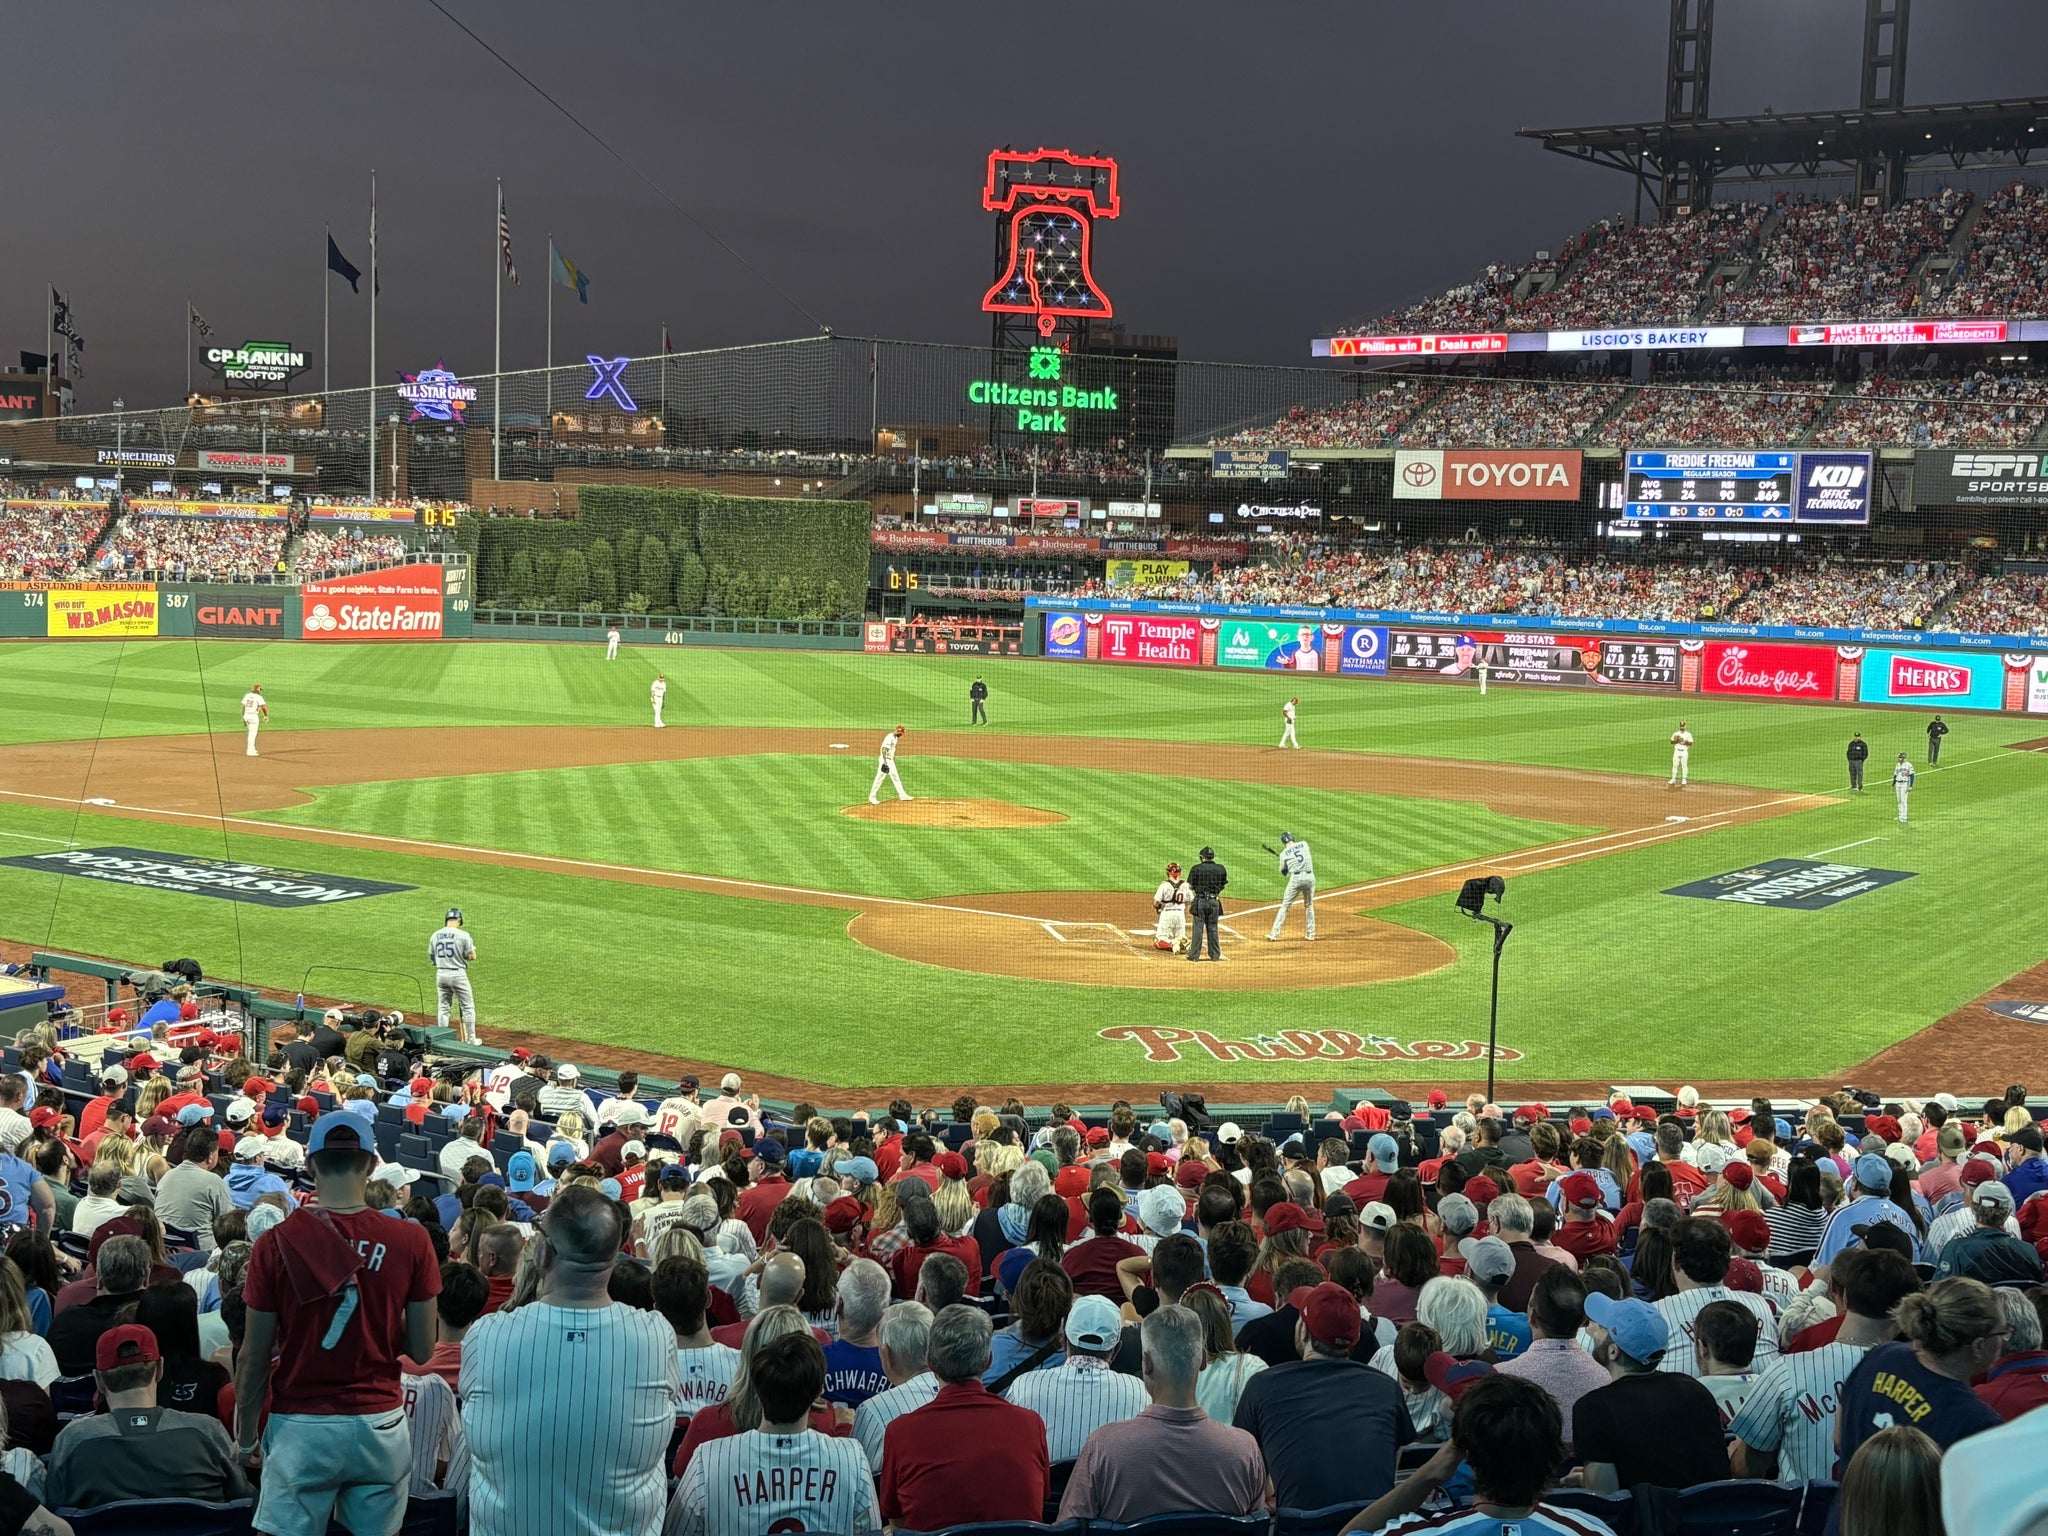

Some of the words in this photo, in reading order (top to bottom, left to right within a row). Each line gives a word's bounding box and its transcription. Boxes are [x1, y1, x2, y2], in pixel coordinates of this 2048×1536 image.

[1582, 334, 1642, 346] LISCIO'S
[1649, 333, 1708, 344] BAKERY
[1830, 334, 1877, 343] FAVORITE
[1881, 334, 1926, 342] PROTEIN
[1938, 330, 1996, 338] INGREDIENTS
[1360, 342, 1396, 352] Phillies
[1399, 342, 1417, 351] win
[1440, 340, 1468, 350] Deals
[1471, 340, 1489, 349] roll
[1491, 339, 1501, 348] in
[226, 370, 286, 380] ROOFTOP
[398, 385, 420, 397] ALL
[420, 385, 447, 399] STAR
[448, 386, 477, 400] GAME
[969, 382, 1057, 406] Citizens
[1062, 386, 1118, 409] Bank
[1018, 409, 1067, 432] Park
[1637, 456, 1643, 466] 5
[1666, 455, 1707, 468] FREDDIE
[1708, 455, 1756, 468] FREEMAN
[1951, 455, 2039, 477] ESPN
[1451, 464, 1569, 486] TOYOTA
[1809, 465, 1866, 488] KDI
[1641, 480, 1660, 488] AVG
[1758, 481, 1778, 489] OPS
[1680, 489, 1697, 500] 24
[1719, 490, 1736, 500] 90
[1820, 489, 1851, 500] OFFICE
[1988, 496, 2019, 504] problem?
[2020, 496, 2034, 504] Call
[1806, 498, 1864, 511] TECHNOLOGY
[216, 505, 257, 517] Surfside
[333, 508, 372, 520] Surfside
[889, 533, 935, 545] Budweiser
[957, 535, 1007, 547] #HITTHEBUDS
[1042, 538, 1088, 550] Budweiser
[1142, 564, 1170, 575] PLAY
[27, 582, 82, 590] ASPLUNDH
[95, 583, 149, 591] ASPLUNDH
[307, 585, 323, 593] Like
[329, 586, 346, 595] good
[378, 586, 395, 594] State
[397, 586, 412, 594] Farm
[414, 586, 420, 594] is
[421, 586, 440, 595] there.
[24, 593, 44, 607] 374
[54, 602, 70, 610] WHO
[72, 601, 85, 609] BUT
[166, 595, 189, 608] 387
[453, 600, 469, 612] 409
[197, 606, 283, 626] GIANT
[1410, 614, 1452, 623] Independence
[1551, 619, 1596, 629] Independence
[1638, 623, 1666, 632] ibx.com
[1701, 625, 1749, 635] Independence
[664, 632, 684, 644] 401
[1138, 621, 1196, 643] Temple
[1795, 630, 1824, 638] ibx.com
[1861, 632, 1912, 642] Independence
[1360, 638, 1371, 649] R
[1504, 634, 1527, 643] 2025
[1527, 635, 1556, 645] STATS
[1960, 636, 1992, 645] ibx.com
[1138, 641, 1191, 660] Health
[1509, 647, 1549, 658] FREEMAN
[1343, 657, 1386, 666] ROTHMAN
[1717, 651, 1820, 692] Chick-fil-A
[1897, 666, 1962, 690] HERR'S
[1293, 850, 1304, 863] 5
[32, 851, 366, 902] POSTSEASON
[1715, 863, 1871, 905] POSTSEASON
[436, 942, 455, 958] 25
[1097, 1025, 1527, 1062] Phillies
[1872, 1371, 1933, 1423] HARPER
[733, 1467, 837, 1508] HARPER
